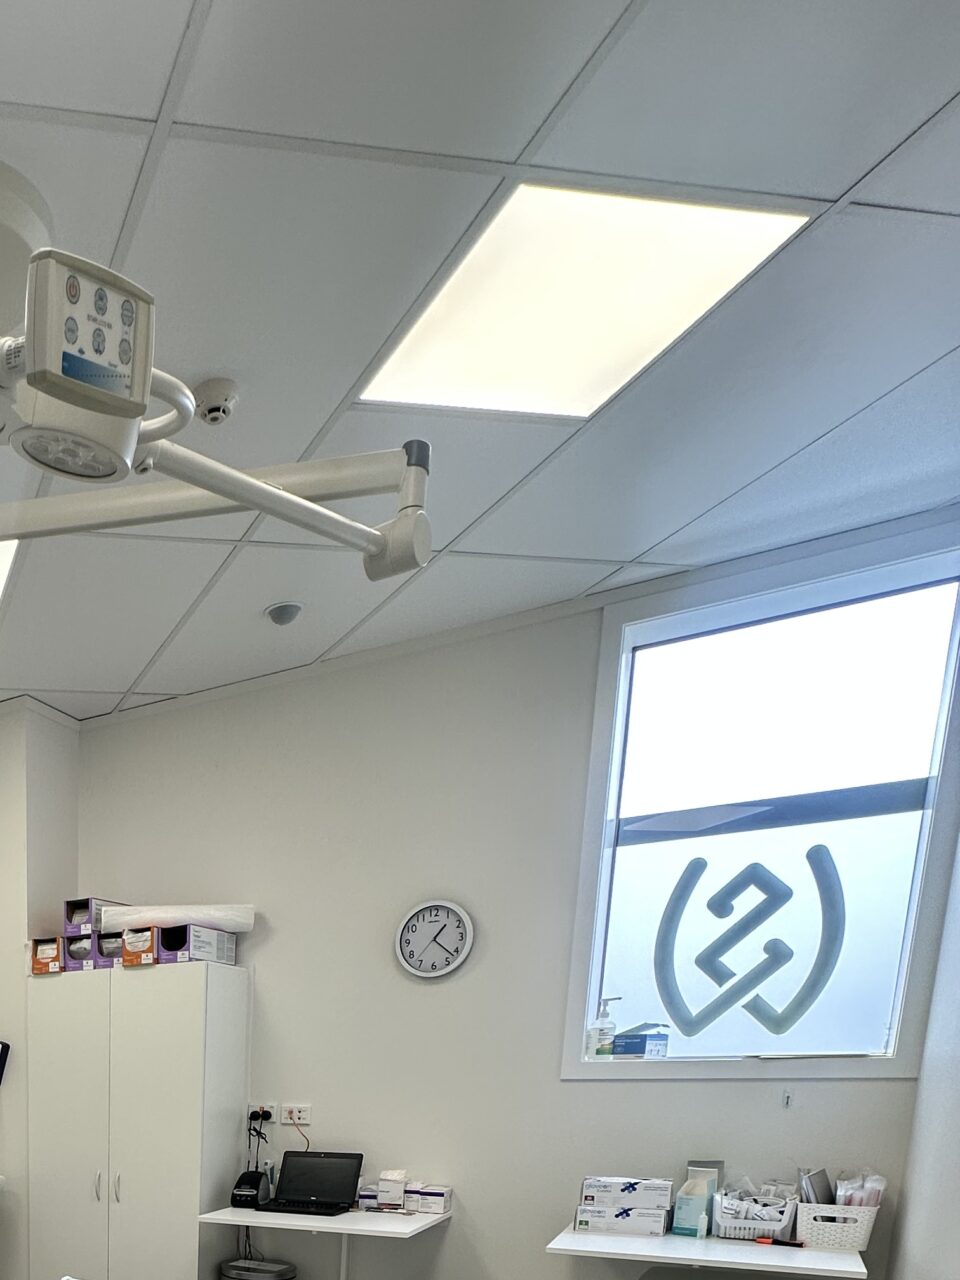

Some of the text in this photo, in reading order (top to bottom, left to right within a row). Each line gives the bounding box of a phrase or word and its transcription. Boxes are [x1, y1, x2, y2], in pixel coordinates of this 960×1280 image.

[429, 908, 440, 918] 12
[416, 913, 425, 923] 11
[455, 919, 462, 929] 2
[406, 924, 417, 934] 10
[458, 932, 464, 941] 3
[405, 939, 411, 947] 9
[408, 950, 415, 959] 8
[417, 959, 423, 968] 7
[431, 961, 437, 970] 6
[445, 957, 451, 966] 5
